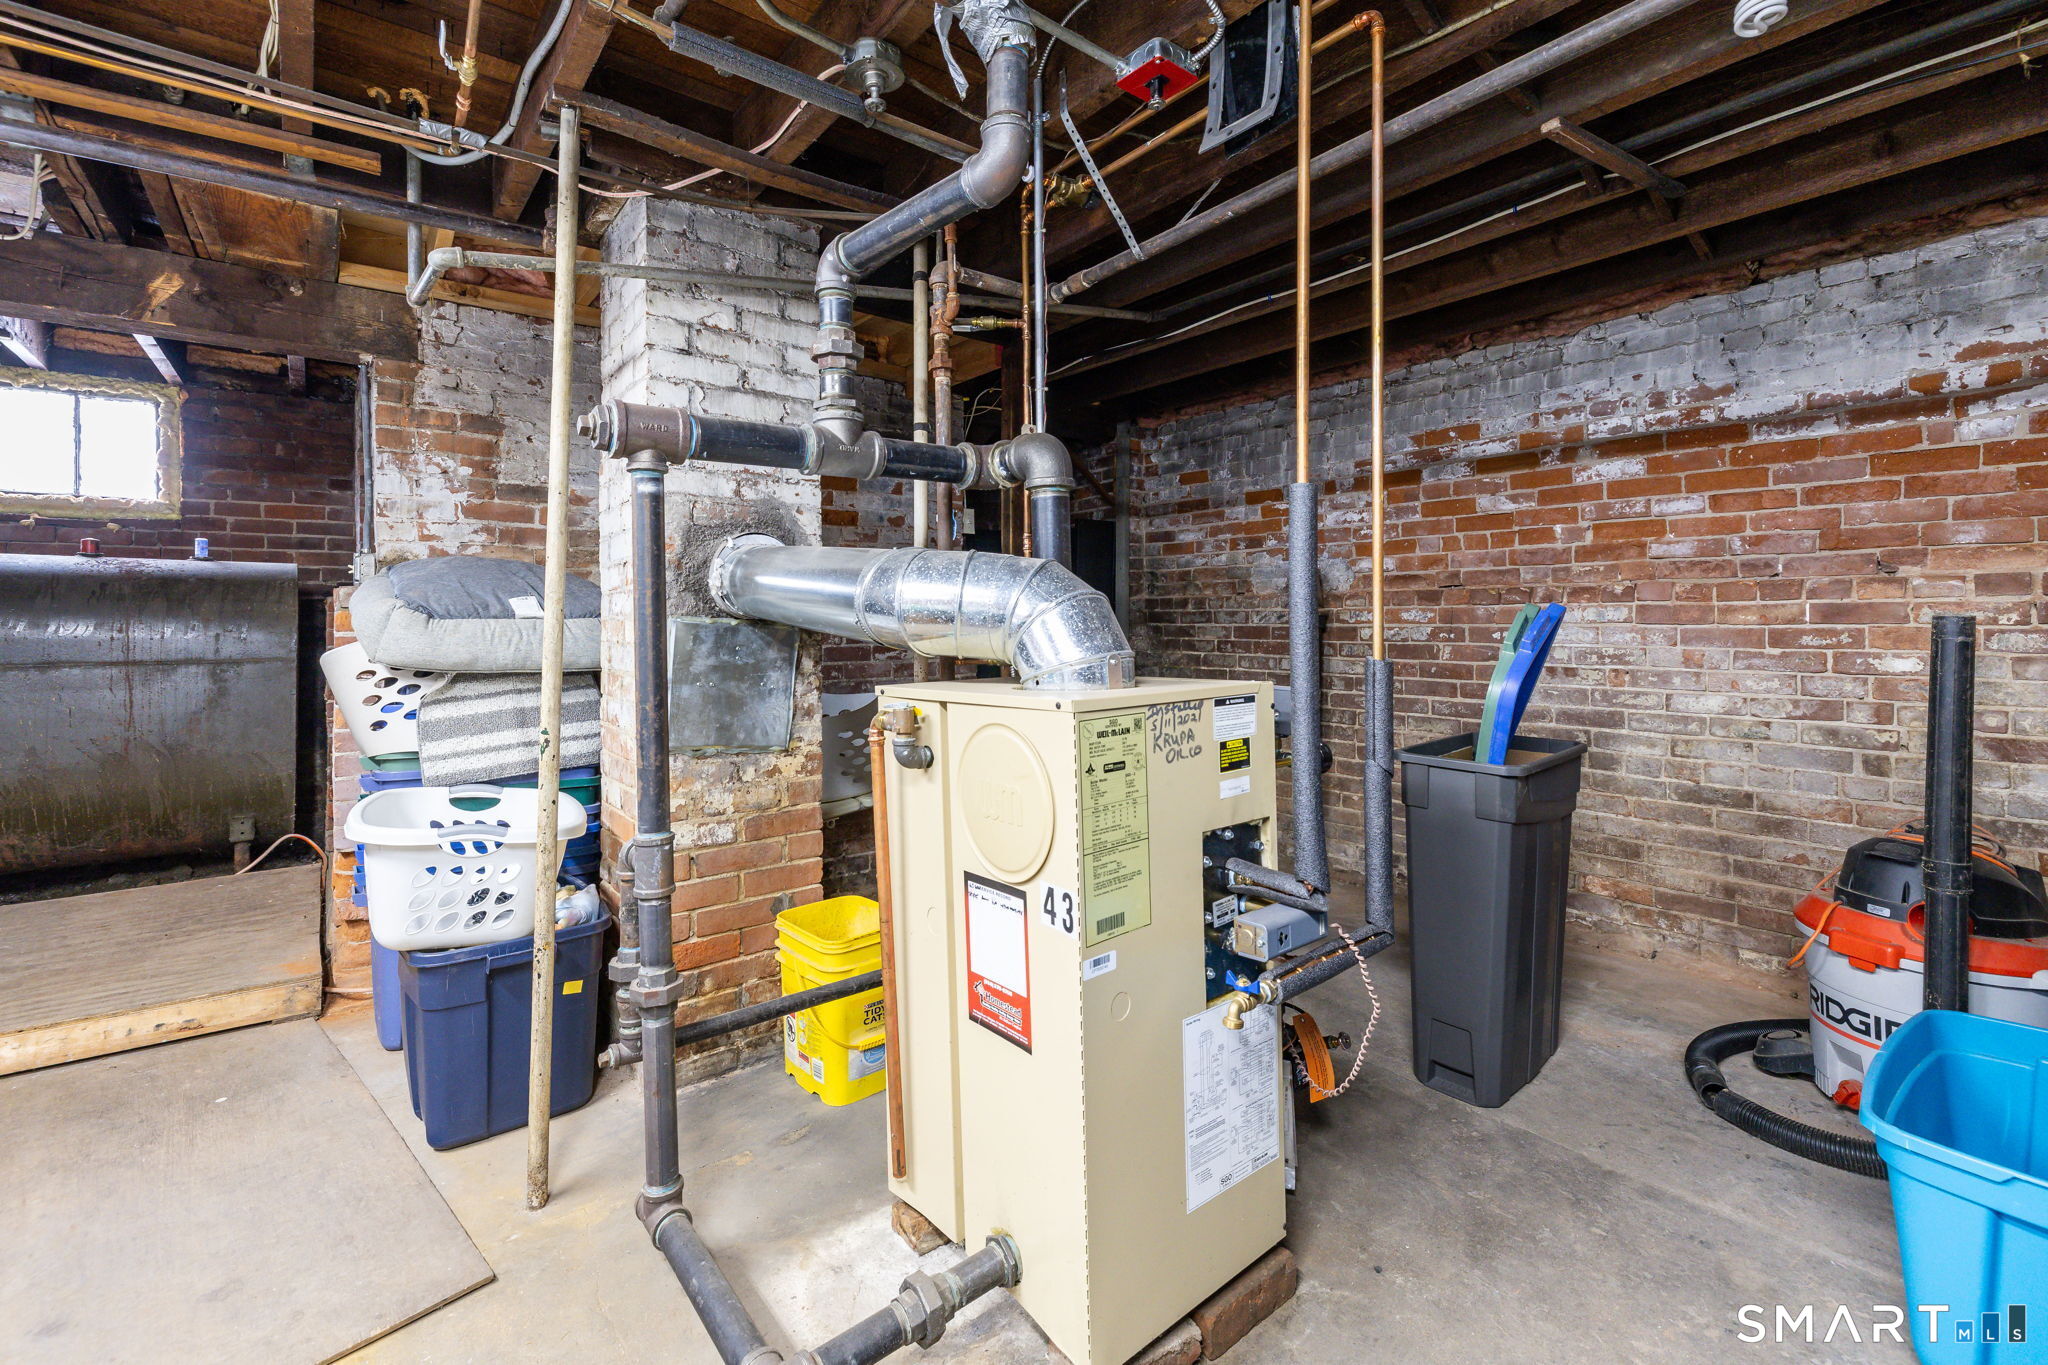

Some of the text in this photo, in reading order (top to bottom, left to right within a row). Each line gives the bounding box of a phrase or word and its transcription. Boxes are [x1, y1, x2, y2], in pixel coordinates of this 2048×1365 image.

[640, 422, 669, 433] WARD
[1153, 728, 1195, 754] KRUPA
[985, 991, 1022, 1018] Homestead
[863, 1013, 885, 1026] CAT
